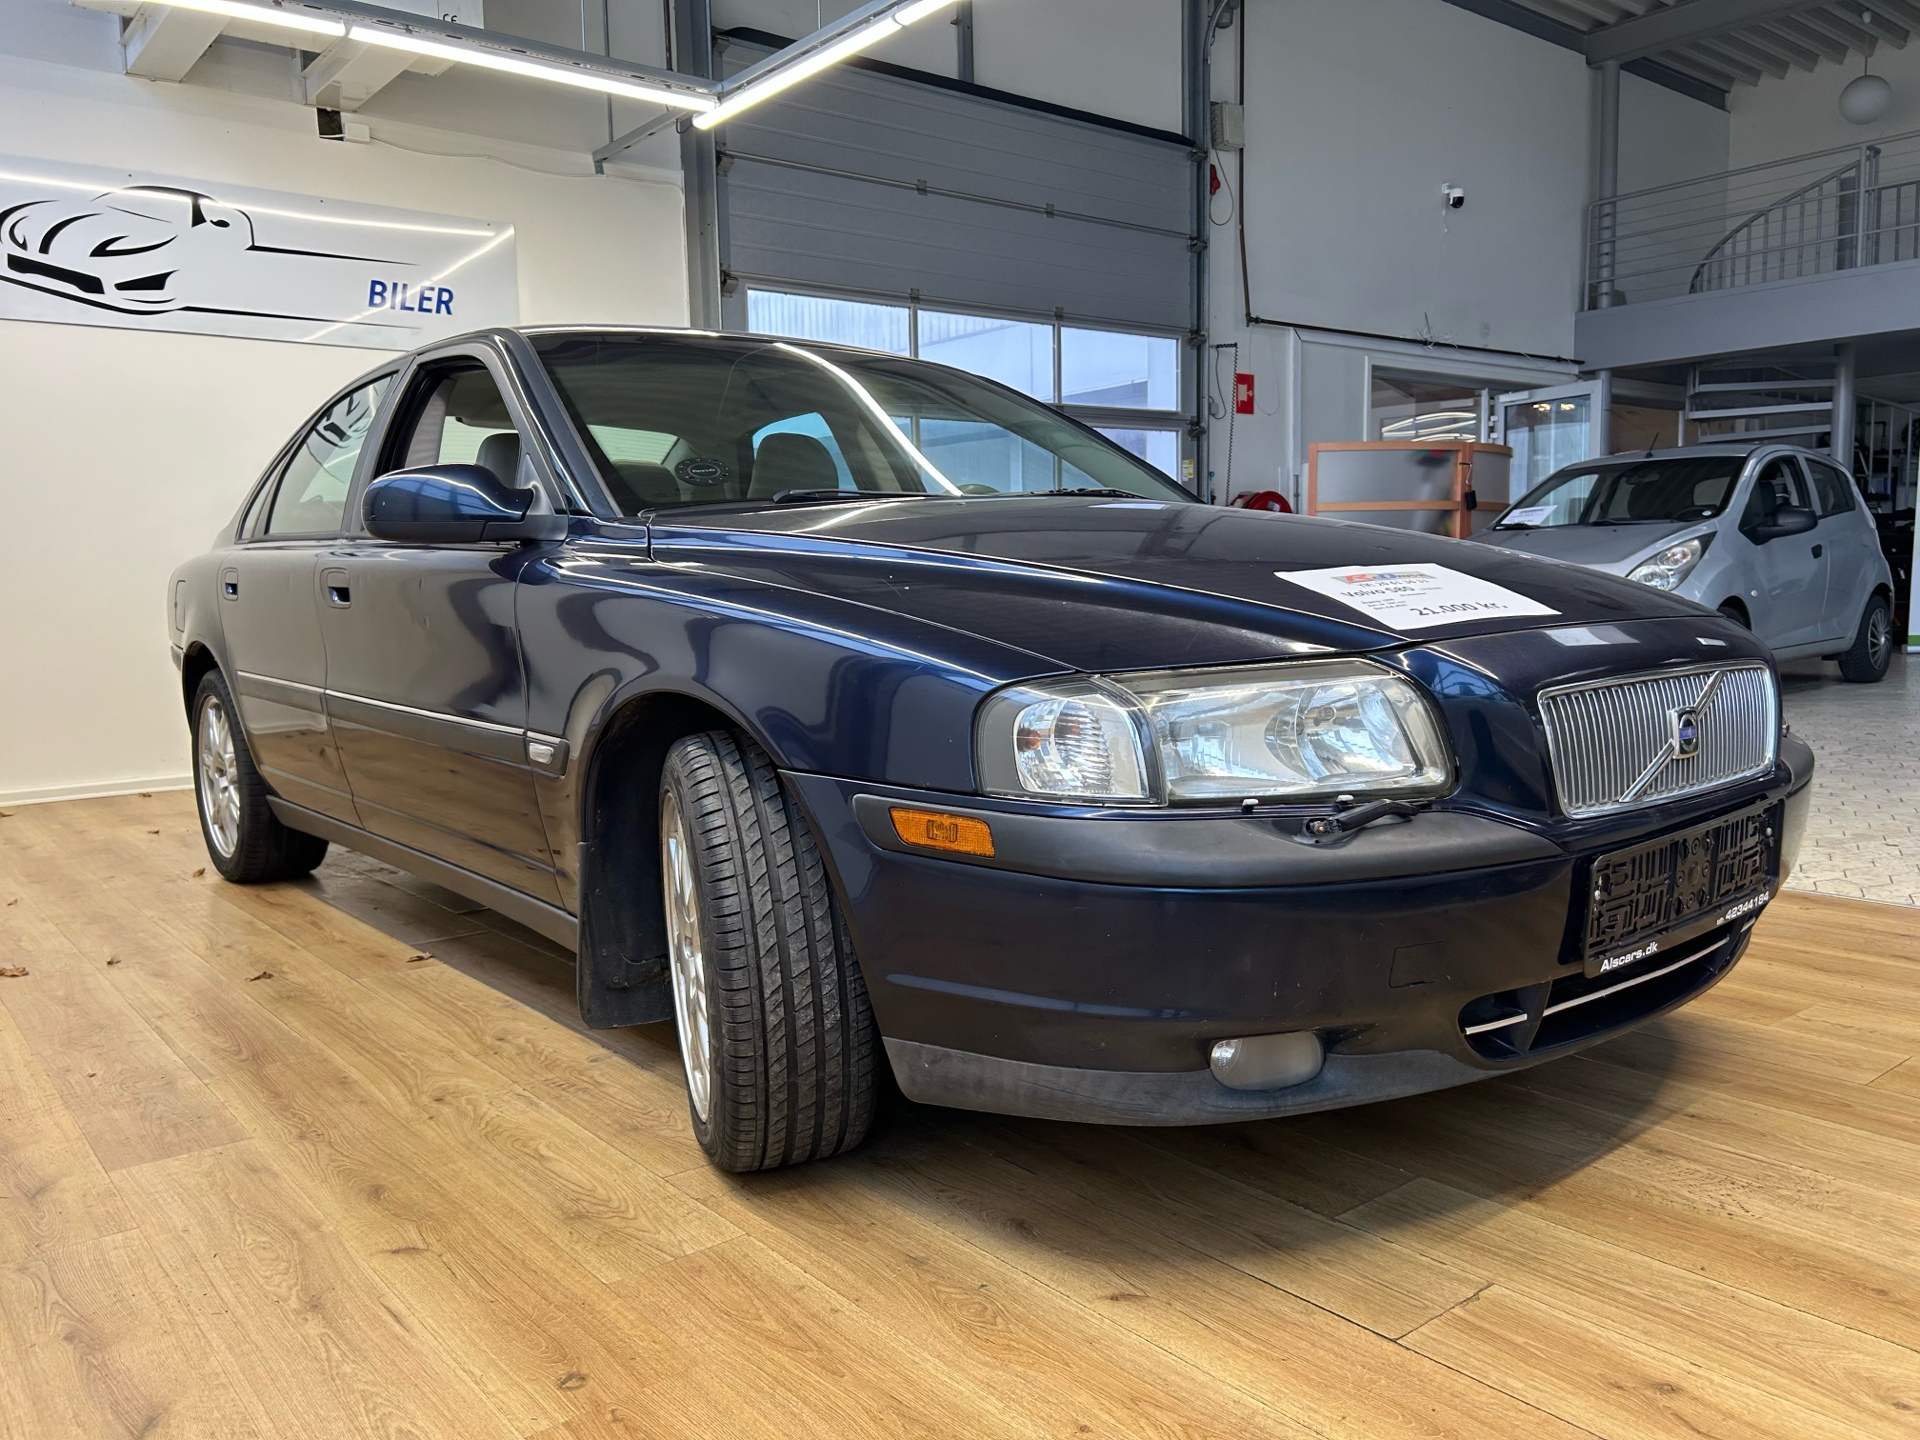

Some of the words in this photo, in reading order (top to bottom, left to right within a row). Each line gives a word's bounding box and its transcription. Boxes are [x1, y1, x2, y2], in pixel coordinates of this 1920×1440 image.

[368, 279, 454, 316] BILER
[1340, 589, 1386, 598] Volvo
[1410, 602, 1479, 616] 21.000
[1476, 601, 1508, 610] kr.
[1600, 941, 1658, 973] Alscars.dk
